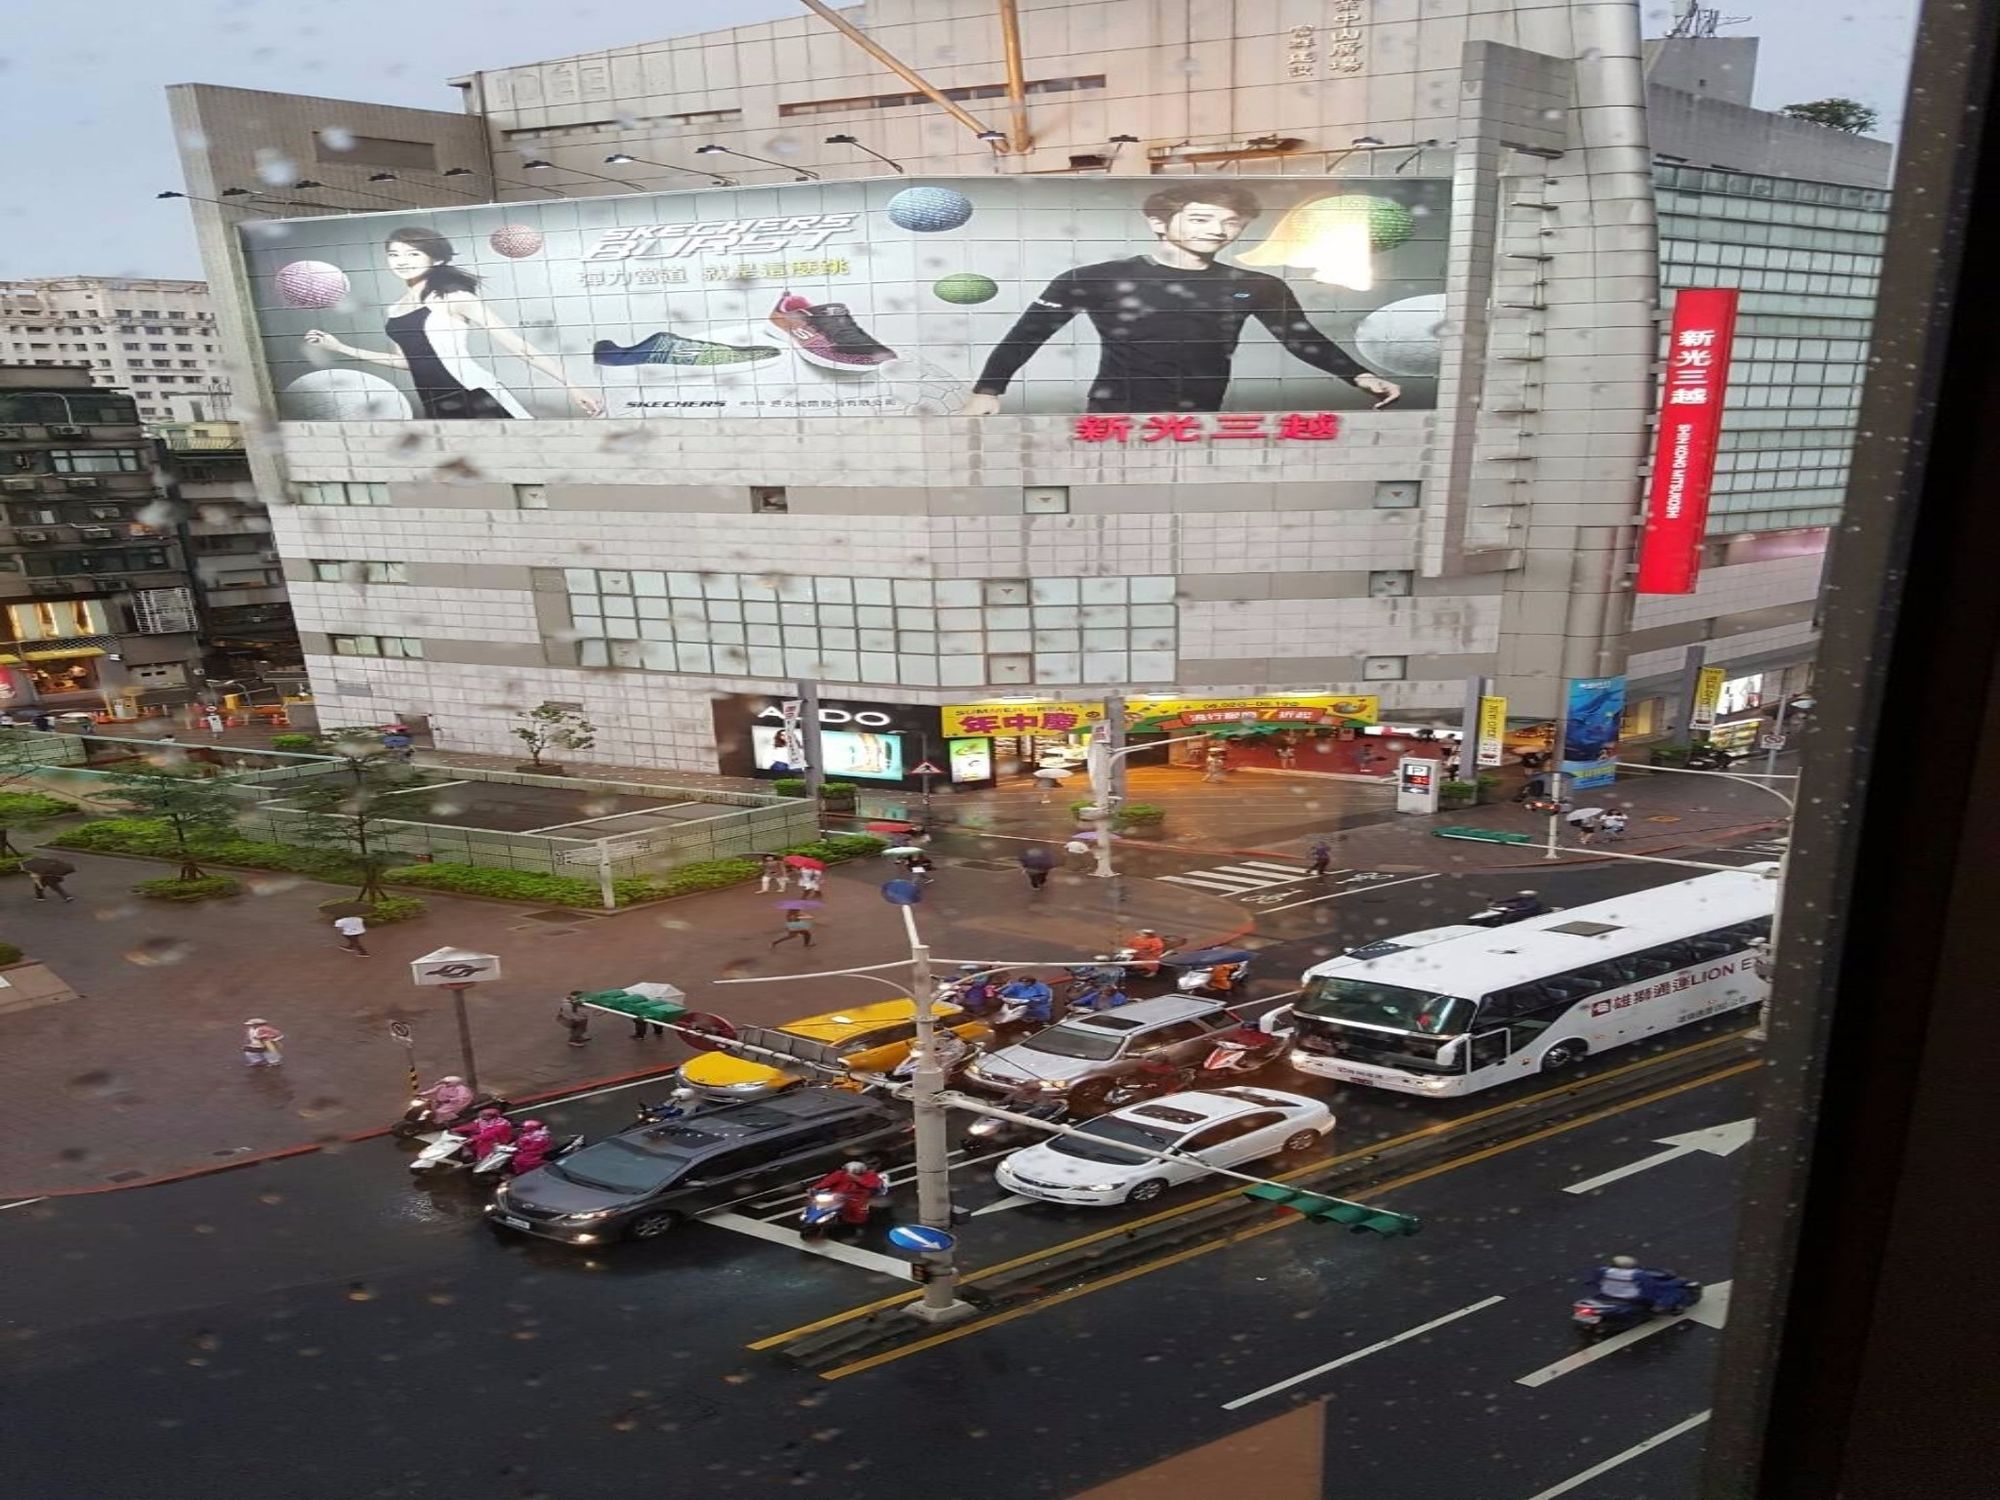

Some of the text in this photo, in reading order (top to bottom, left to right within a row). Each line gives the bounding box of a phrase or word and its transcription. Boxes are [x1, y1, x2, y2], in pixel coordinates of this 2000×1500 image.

[600, 213, 858, 242] SKECHERS
[579, 227, 855, 262] BURST
[1670, 329, 1715, 405] 新光三越
[624, 400, 727, 408] SKECHERS
[1074, 412, 1339, 442] 新光三越
[1665, 424, 1692, 519] SHIN KONG MITSUKOSHI
[758, 706, 890, 727] ADO
[959, 712, 1079, 734] 年中慶
[1613, 976, 1691, 1010] 雄獅通運
[1691, 963, 1735, 986] LION
